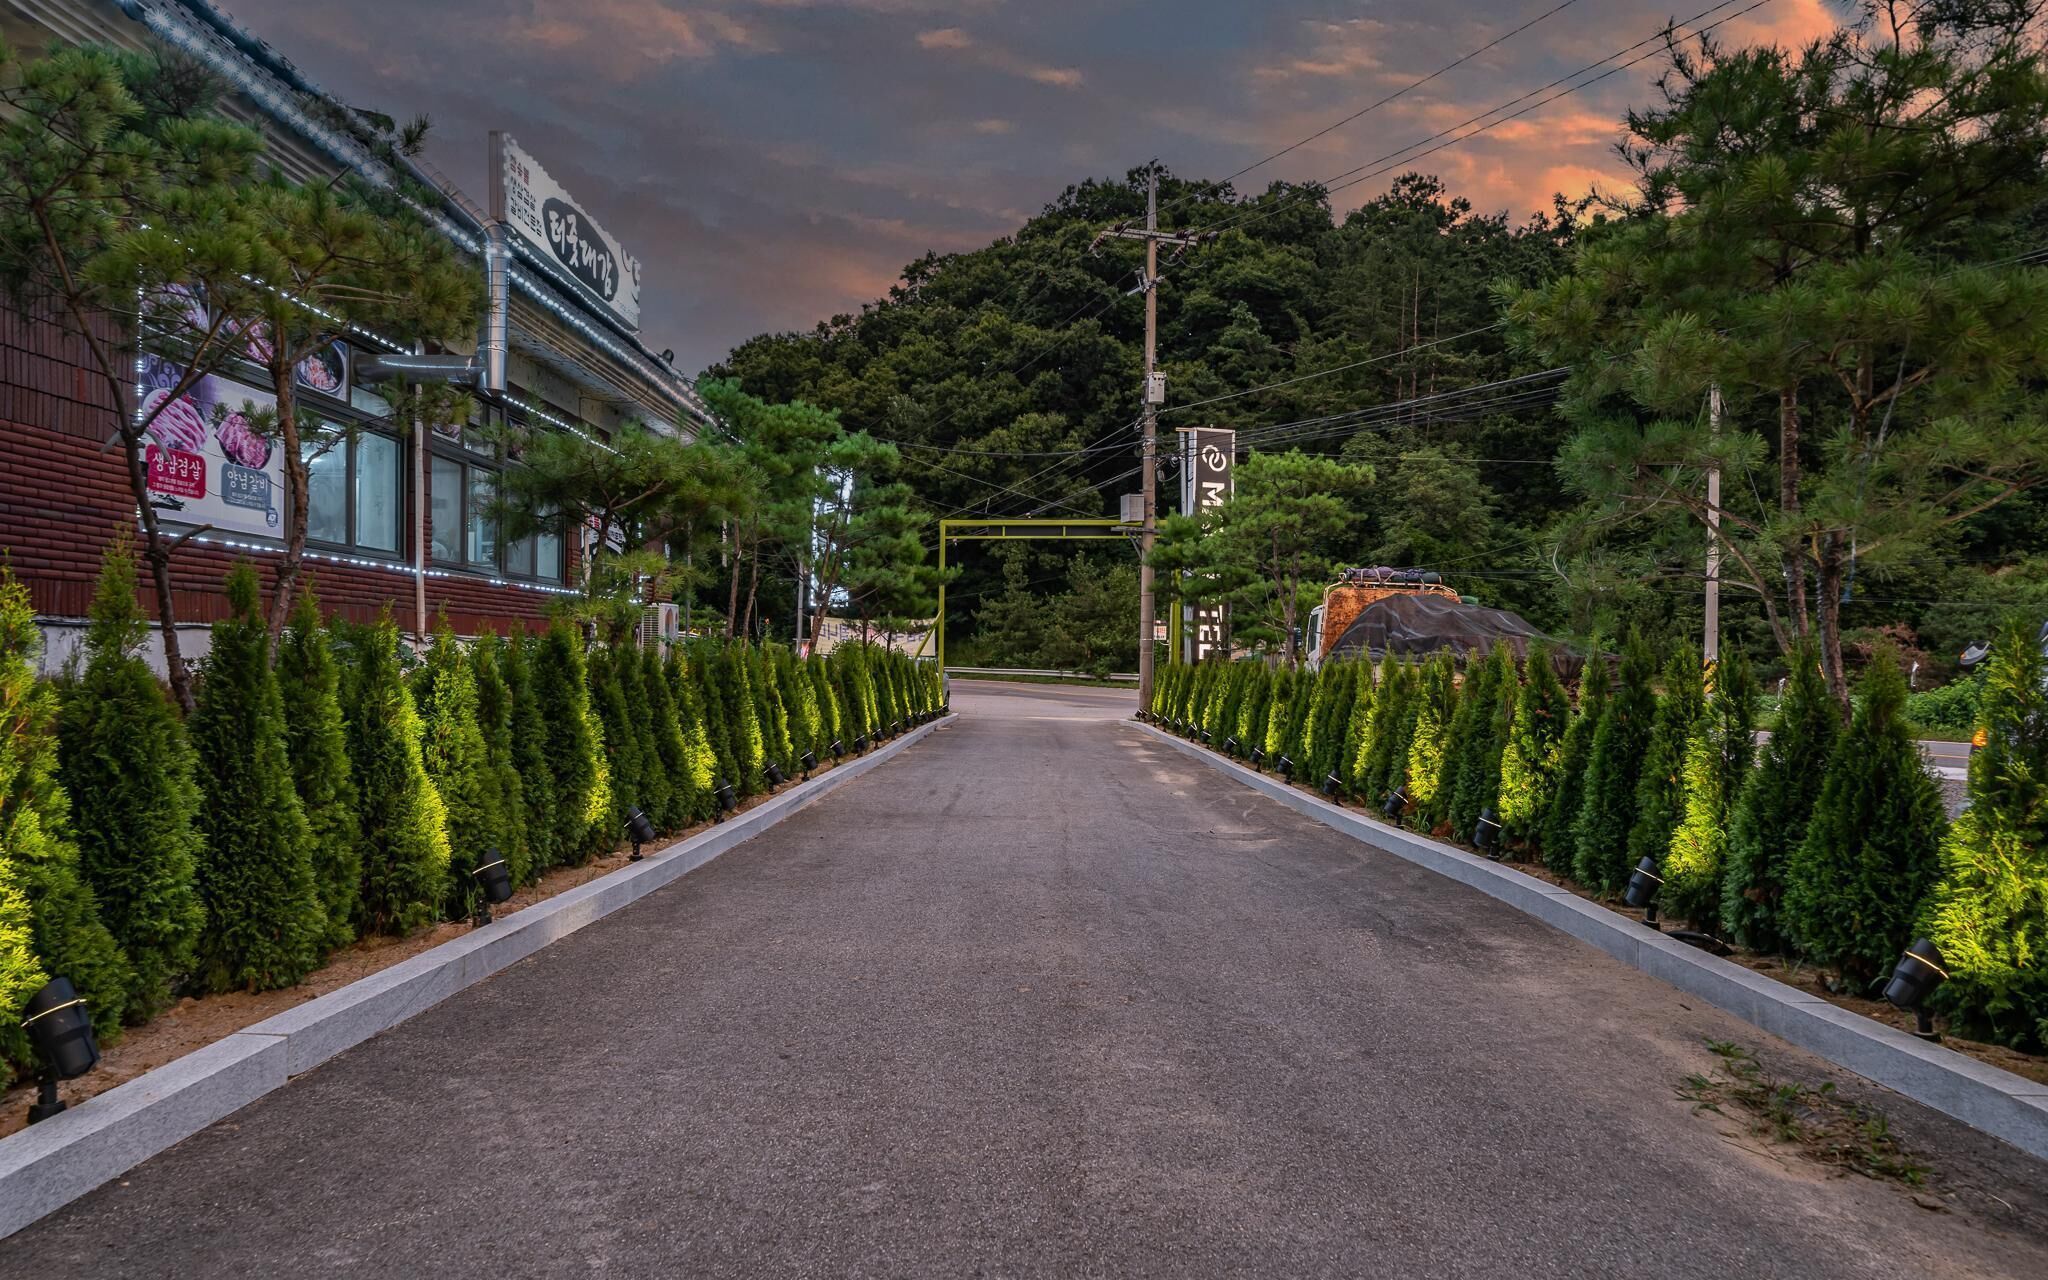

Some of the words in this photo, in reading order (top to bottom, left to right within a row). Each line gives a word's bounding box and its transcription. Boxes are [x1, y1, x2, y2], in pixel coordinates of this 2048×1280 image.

[510, 197, 543, 237] 갈비전문점
[152, 452, 202, 480] 생삼겹살
[227, 471, 268, 496] 양념갈비
